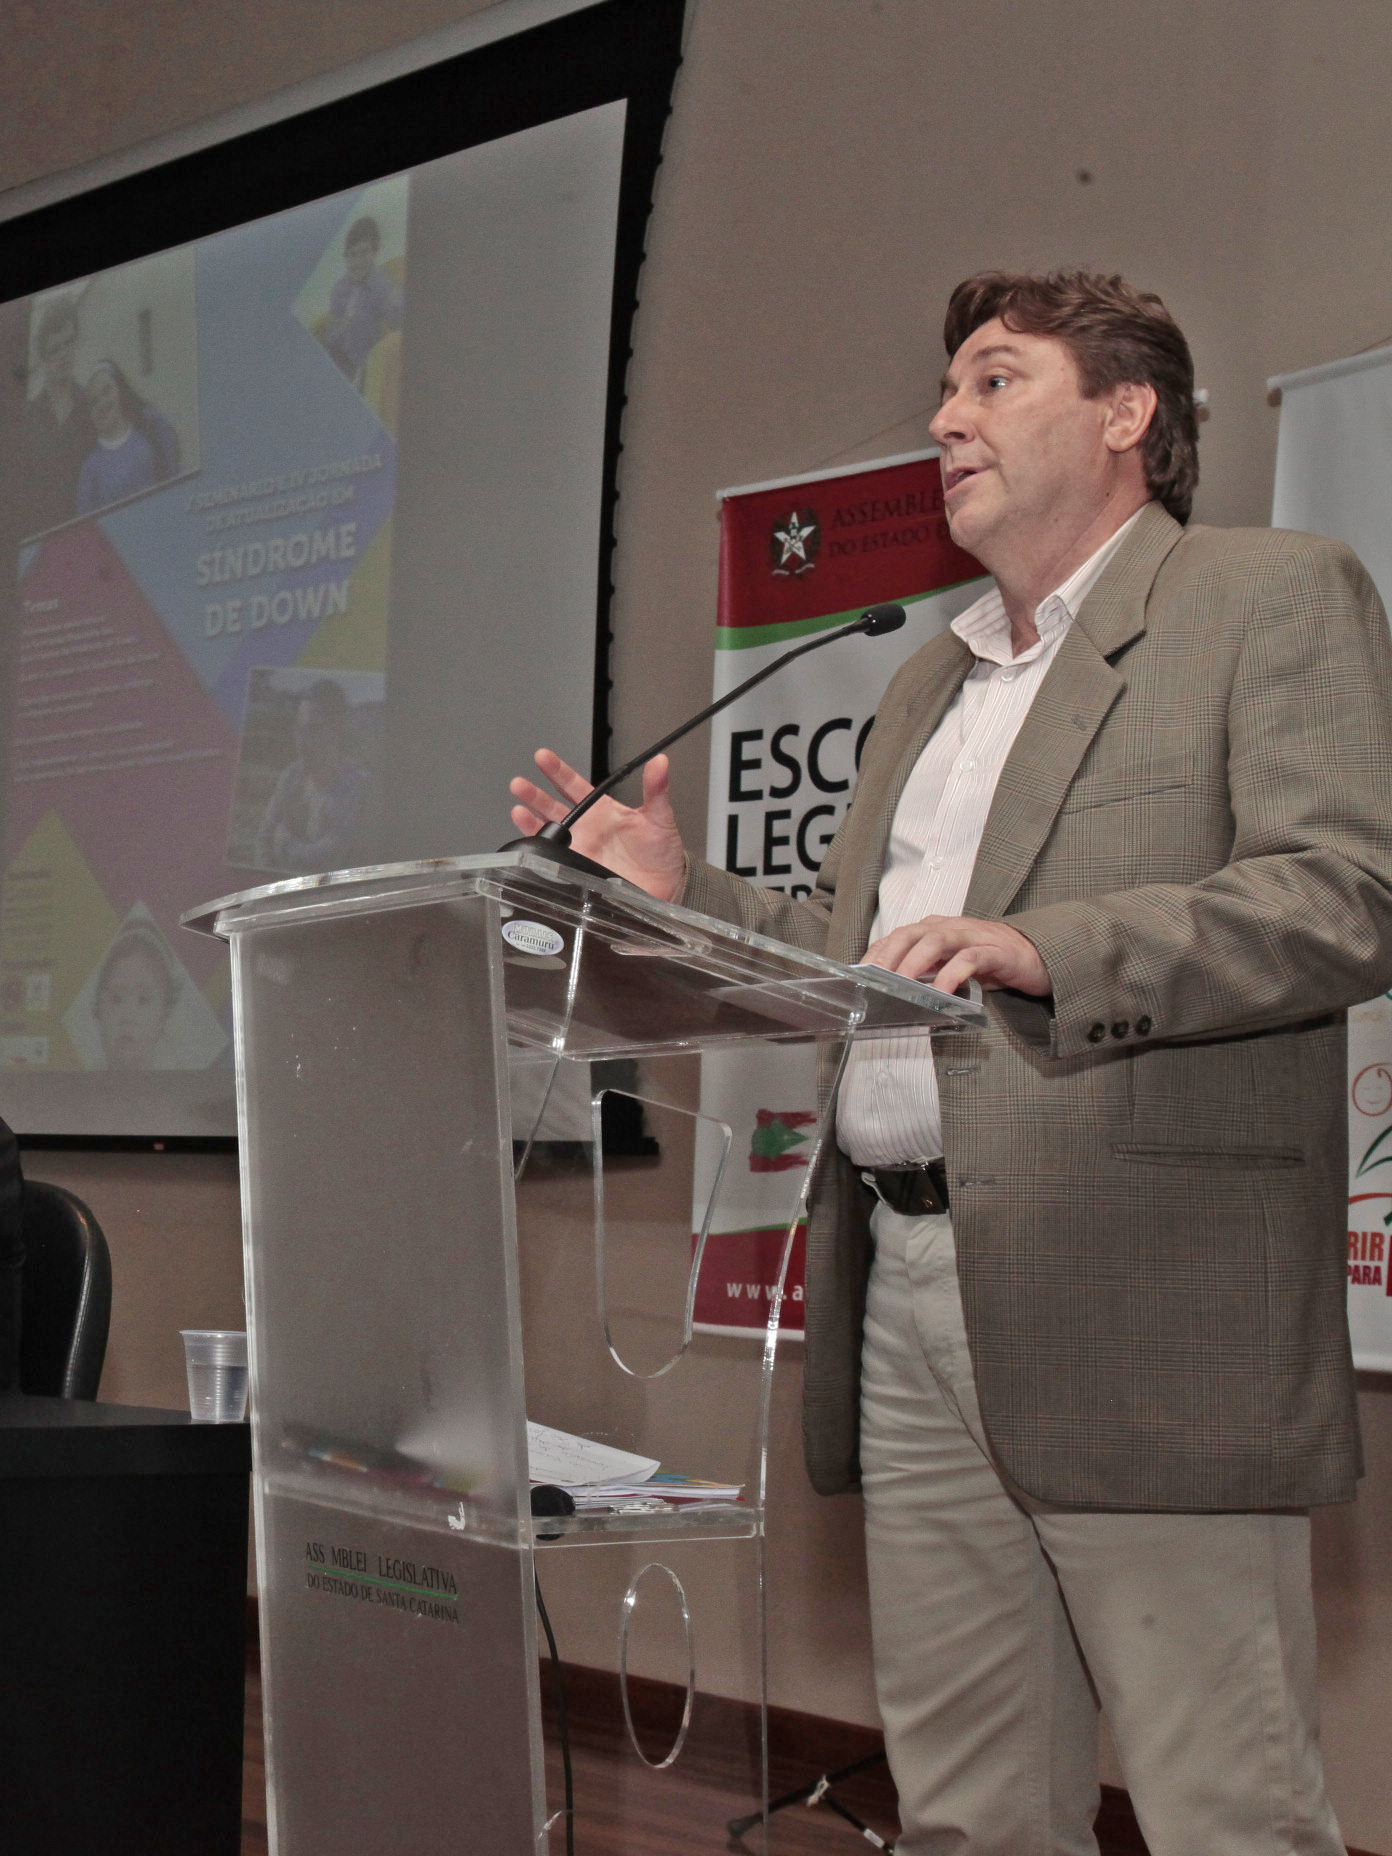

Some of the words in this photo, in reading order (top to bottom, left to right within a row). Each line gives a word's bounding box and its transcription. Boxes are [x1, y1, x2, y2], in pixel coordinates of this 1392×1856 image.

[829, 539, 857, 558] DO
[862, 524, 931, 554] ESTADO
[205, 597, 243, 637] DE
[250, 579, 351, 629] DOWN
[728, 714, 875, 803] ESC
[725, 803, 848, 877] LEG
[307, 1573, 320, 1589] DO
[323, 1575, 357, 1598] ESTADO
[360, 1585, 374, 1602] DE
[376, 1587, 406, 1611] SANTA
[409, 1597, 460, 1624] CATARINA
[378, 1556, 458, 1594] LEGISLATIVA
